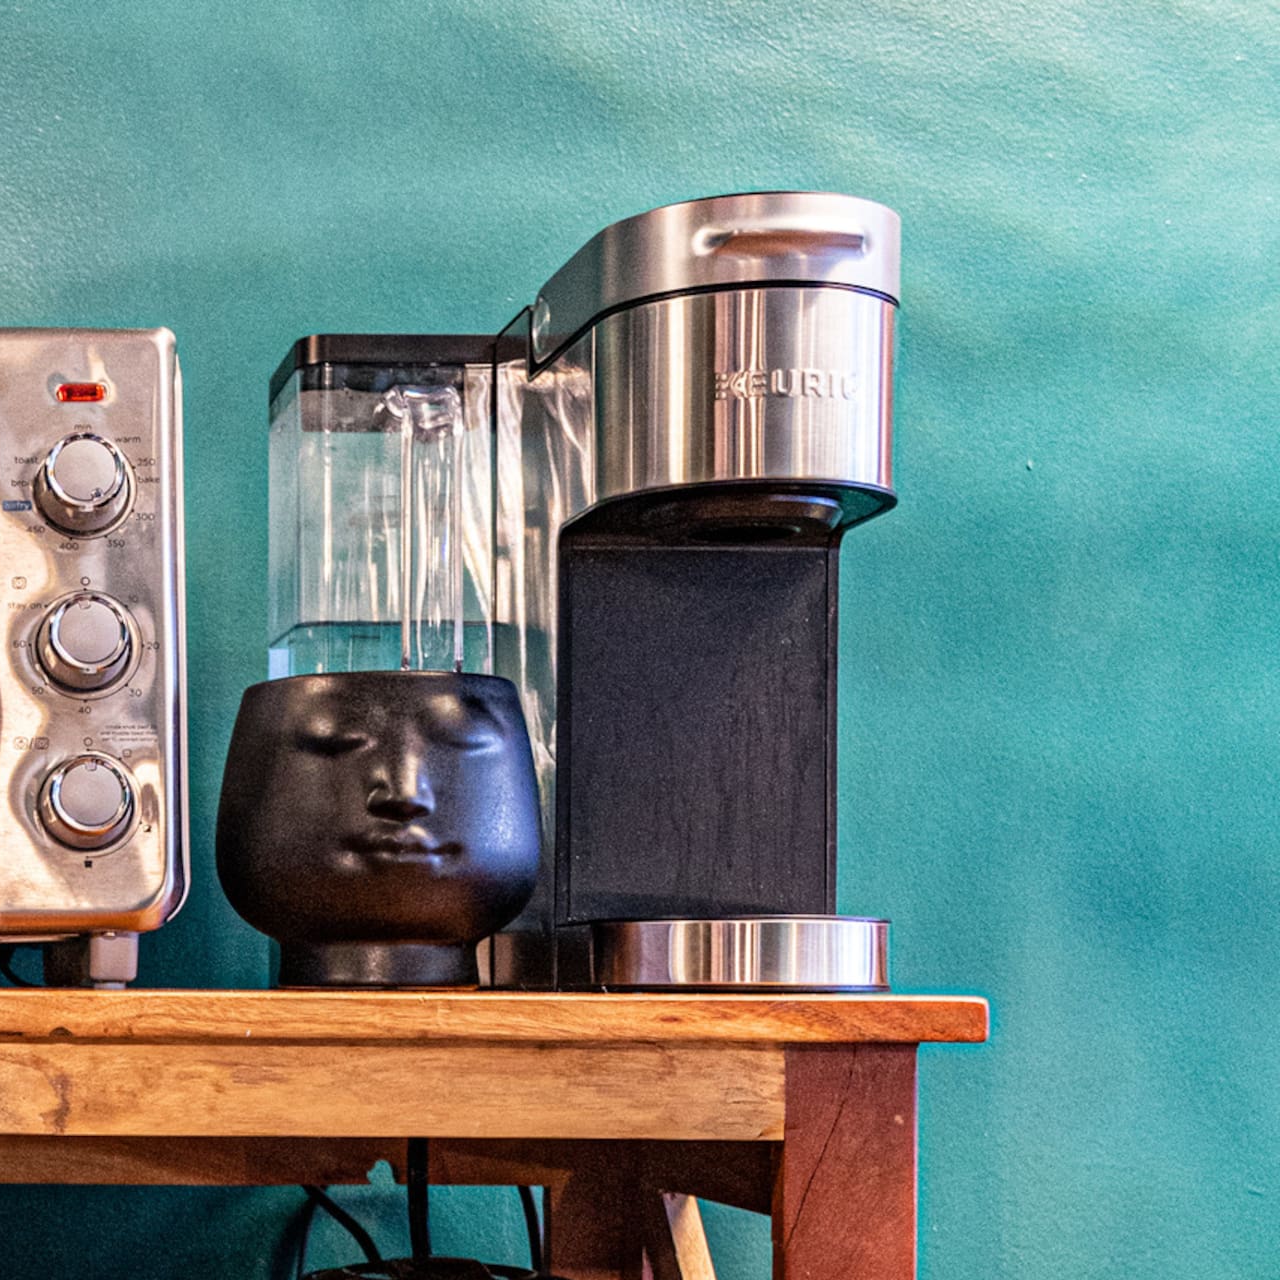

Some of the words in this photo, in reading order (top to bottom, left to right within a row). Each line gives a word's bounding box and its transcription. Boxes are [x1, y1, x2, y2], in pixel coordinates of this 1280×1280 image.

[74, 423, 92, 431] min
[115, 435, 141, 444] warm
[14, 455, 39, 465] toast
[136, 457, 156, 467] 250
[137, 474, 160, 485] bake
[135, 512, 155, 522] 300
[59, 542, 80, 551] 400
[106, 539, 126, 549] 350
[12, 639, 26, 648] 60
[145, 640, 160, 650] 20
[31, 687, 44, 696] 50
[128, 689, 143, 698] 30
[77, 706, 92, 715] 40
